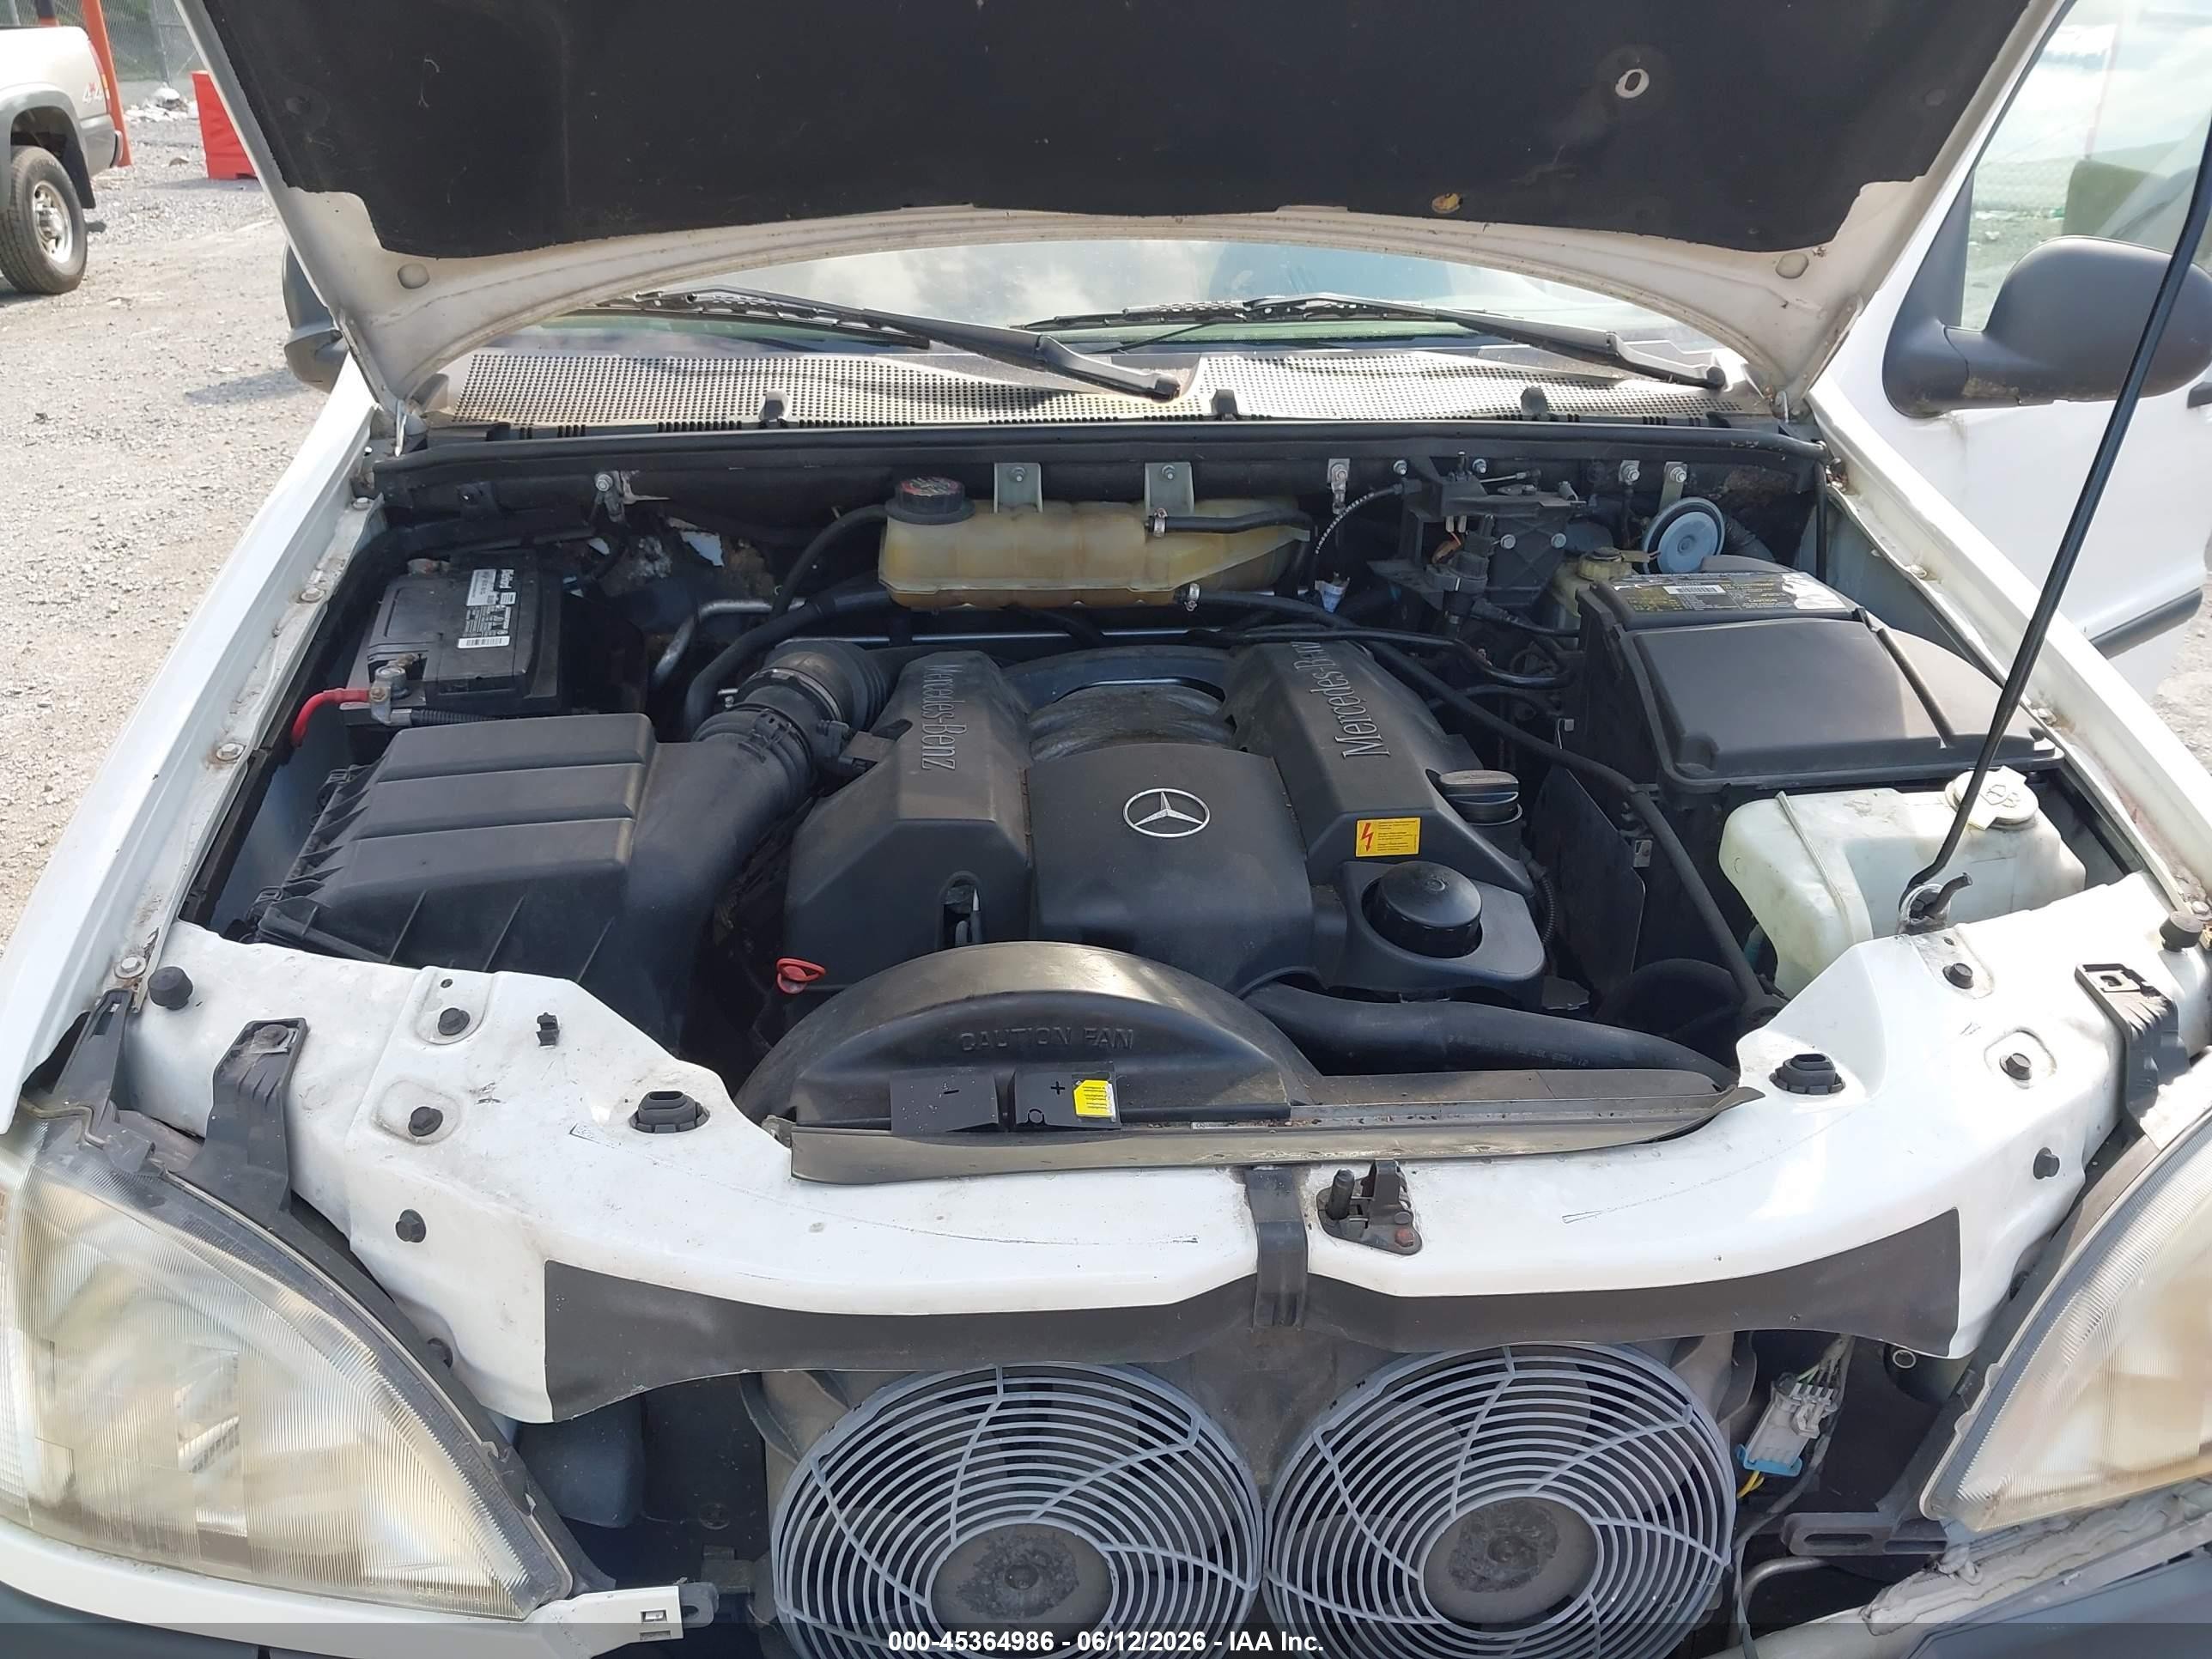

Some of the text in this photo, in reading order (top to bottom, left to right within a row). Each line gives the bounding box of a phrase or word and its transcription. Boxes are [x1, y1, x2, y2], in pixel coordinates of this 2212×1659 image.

[921, 664, 967, 770] Mercedes-Benz
[1290, 641, 1391, 758] Mercedes-Benz
[961, 1028, 1134, 1051] CAUTION FAN
